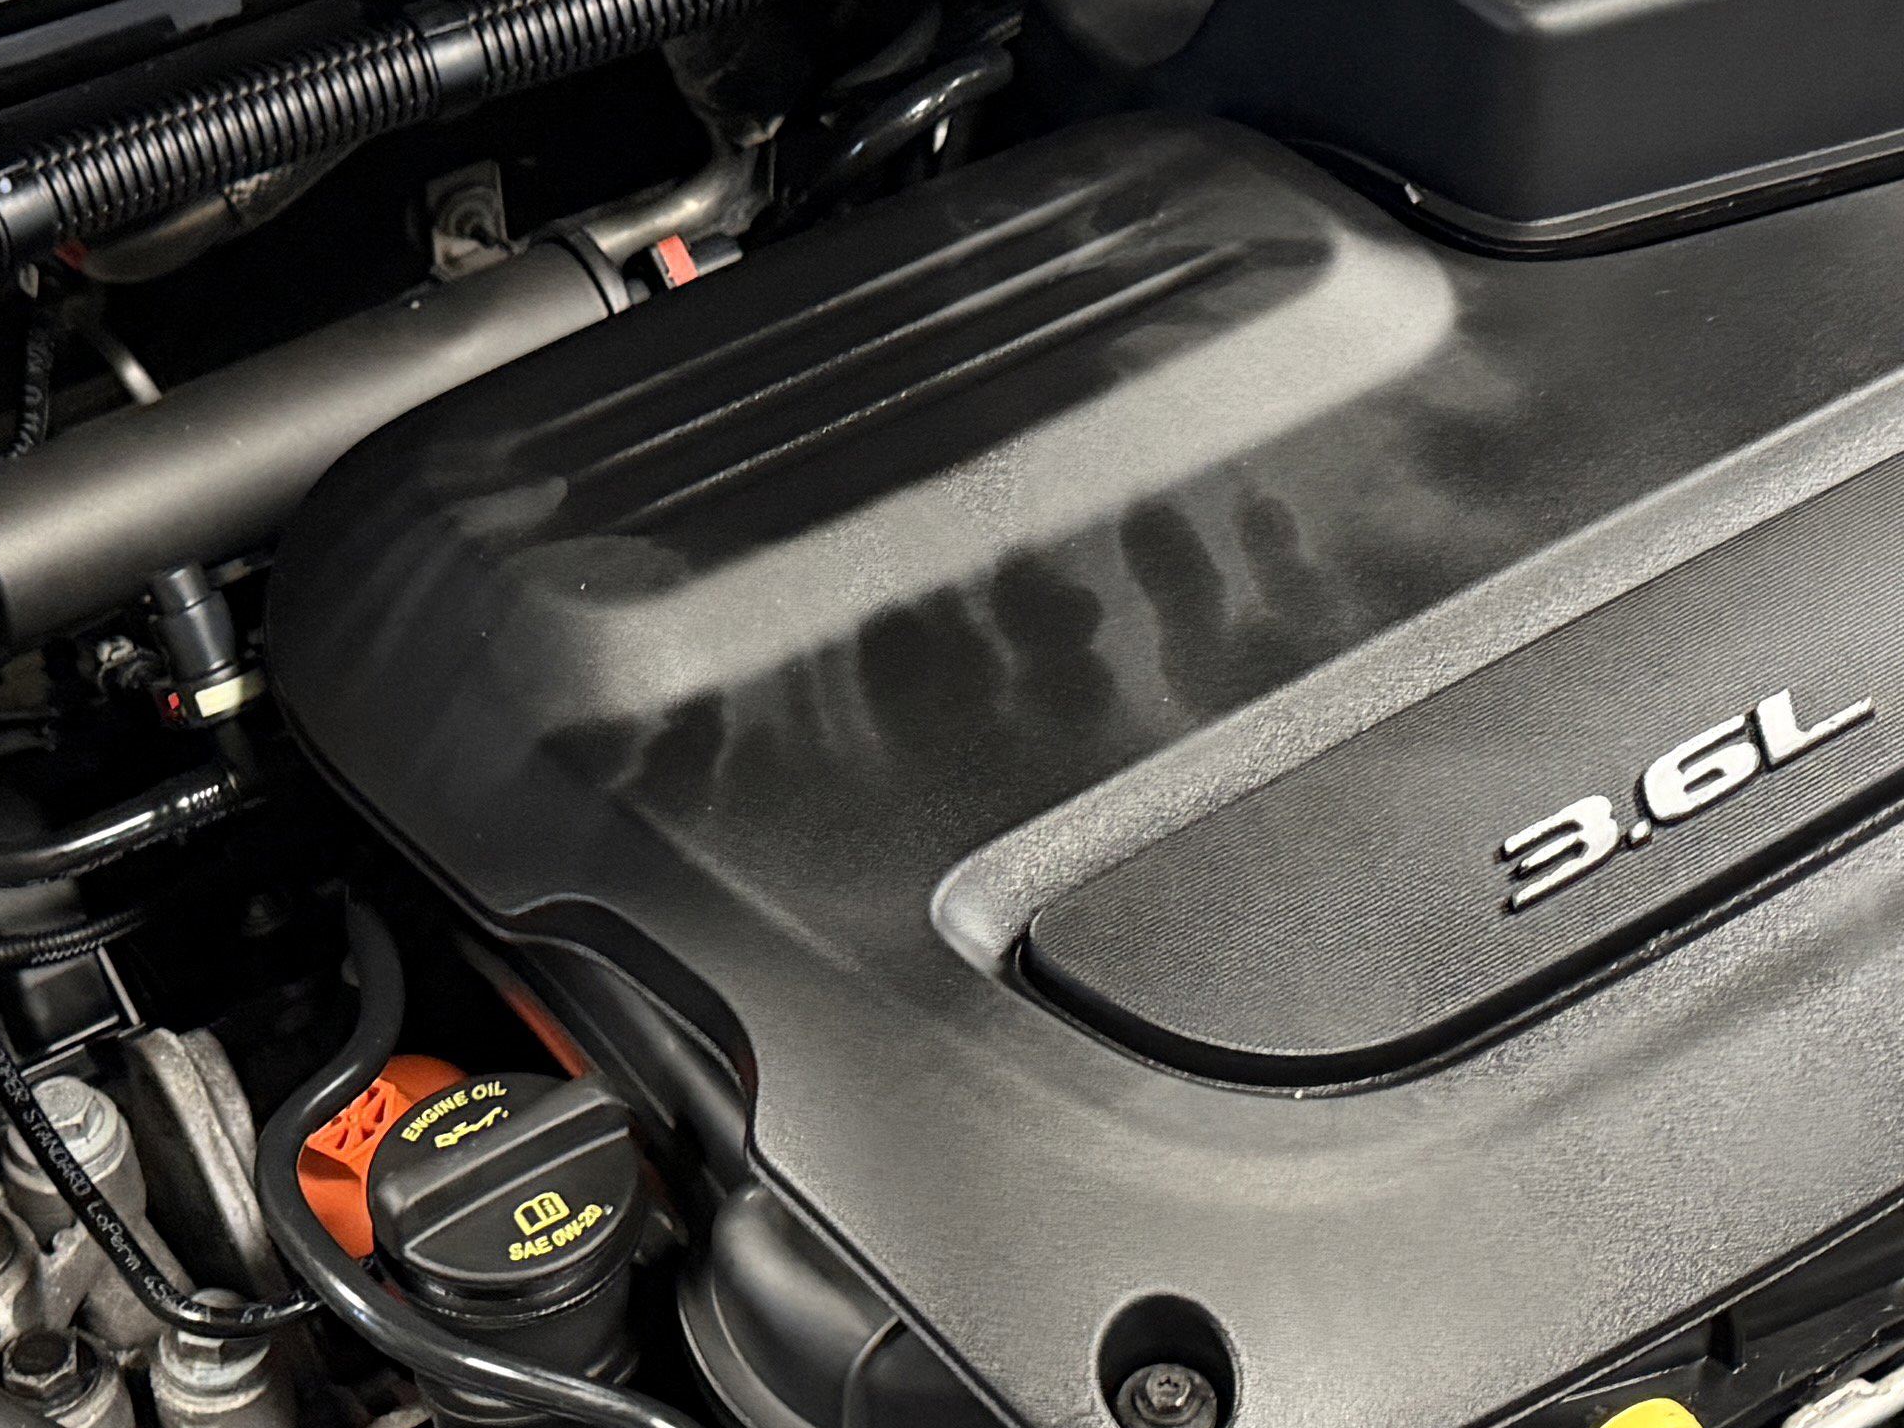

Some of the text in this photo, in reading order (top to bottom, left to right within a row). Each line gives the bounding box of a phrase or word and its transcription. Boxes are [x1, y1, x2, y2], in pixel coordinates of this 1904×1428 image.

[1500, 688, 1876, 912] 3.6L
[400, 1080, 508, 1143] ENGINE OIL
[22, 1108, 93, 1197] STANDARD
[507, 1203, 604, 1262] SAE 0W-20
